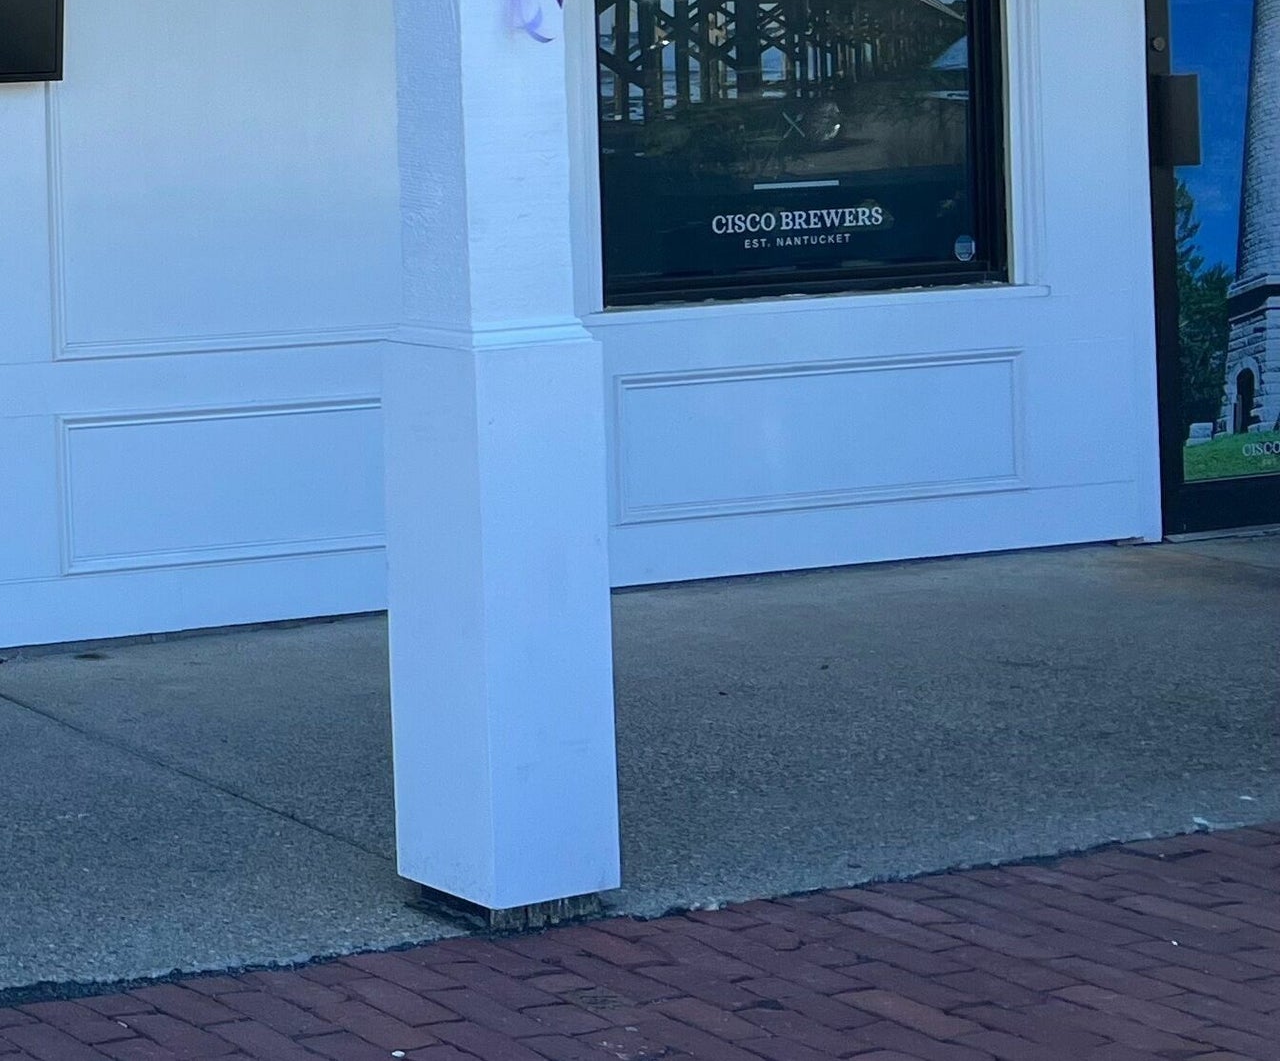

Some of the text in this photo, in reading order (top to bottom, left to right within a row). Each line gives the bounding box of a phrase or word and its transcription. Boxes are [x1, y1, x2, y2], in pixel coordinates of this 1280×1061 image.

[711, 206, 883, 234] CISCO BREWERS
[744, 233, 852, 249] EST. NANTUCKET
[1242, 440, 1280, 457] CISCO
